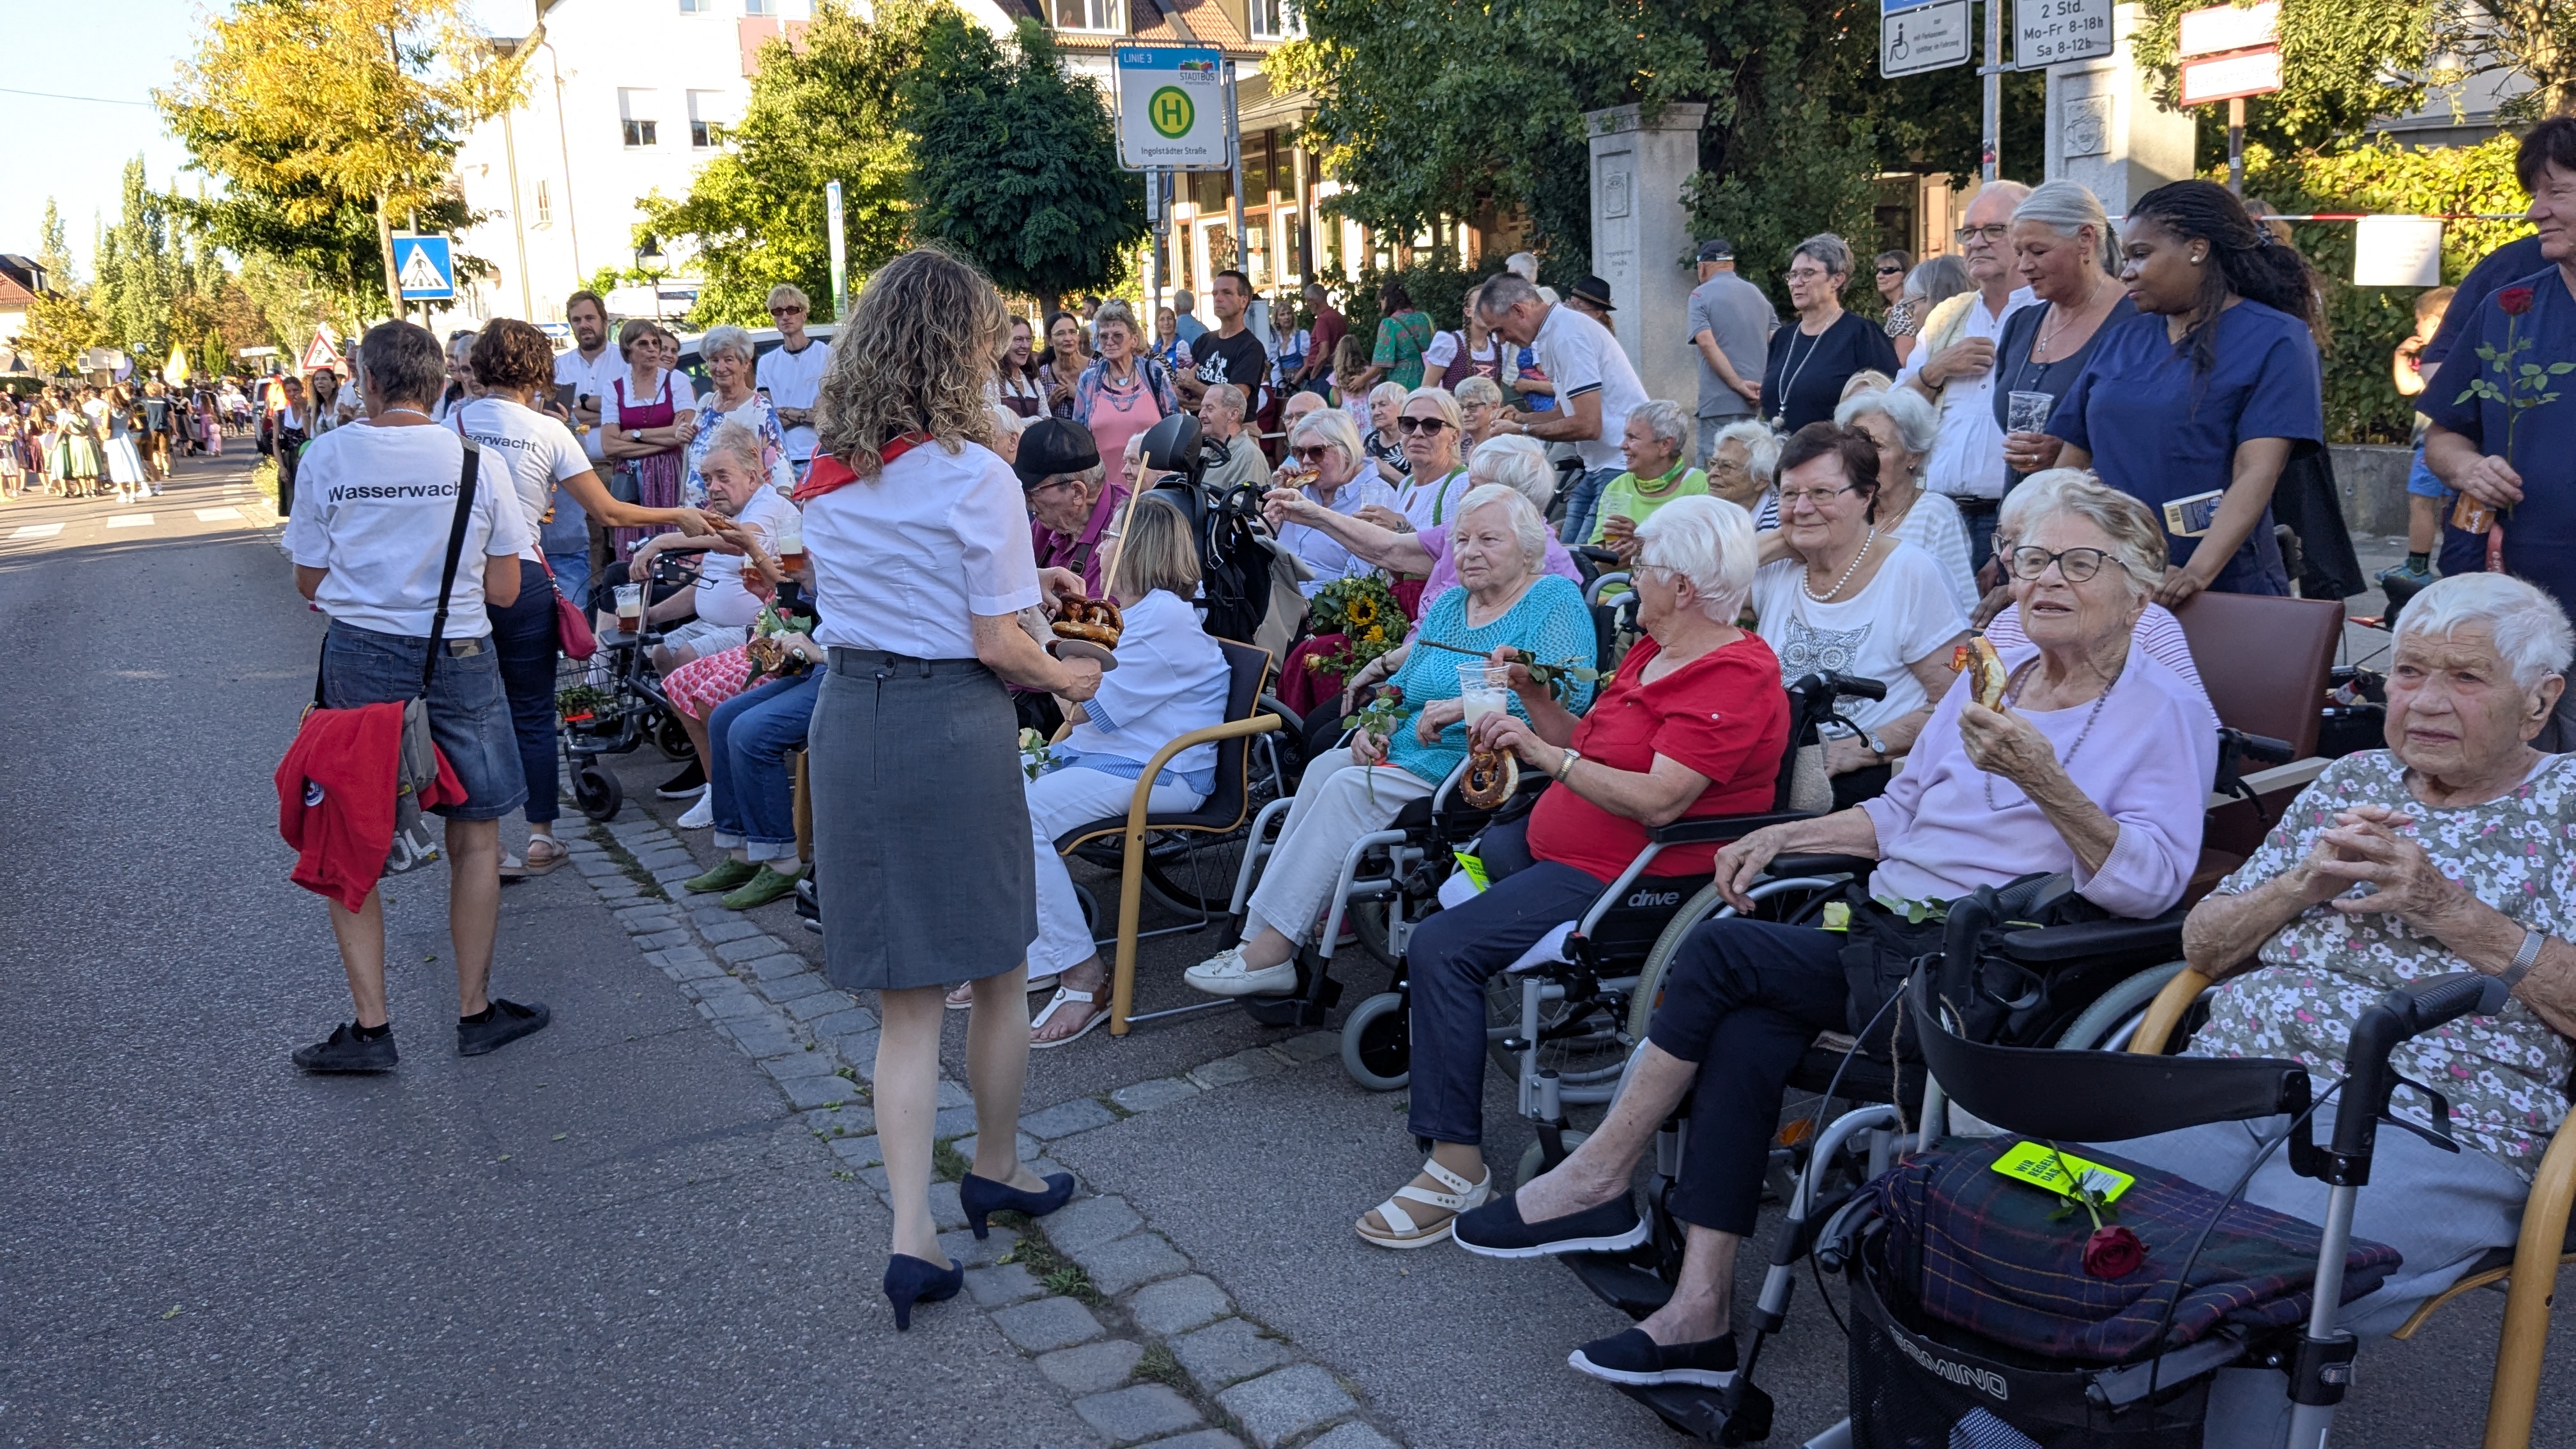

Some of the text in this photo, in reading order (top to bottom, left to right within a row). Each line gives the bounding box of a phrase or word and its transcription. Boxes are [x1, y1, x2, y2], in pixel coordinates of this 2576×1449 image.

[2041, 0, 2085, 19] 2 Std.
[2024, 16, 2103, 40] Mo-Fr 8-18h
[2037, 37, 2092, 57] Sa 8-12h
[1124, 54, 1153, 63] LINIE 3
[1179, 72, 1215, 81] STADTBUS
[1161, 99, 1182, 126] H
[1141, 146, 1207, 157] Ingolstädter Straße
[466, 434, 537, 452] serwacht
[329, 481, 461, 503] Wasserwach
[1628, 889, 1680, 907] drive
[2014, 1160, 2035, 1172] WIR
